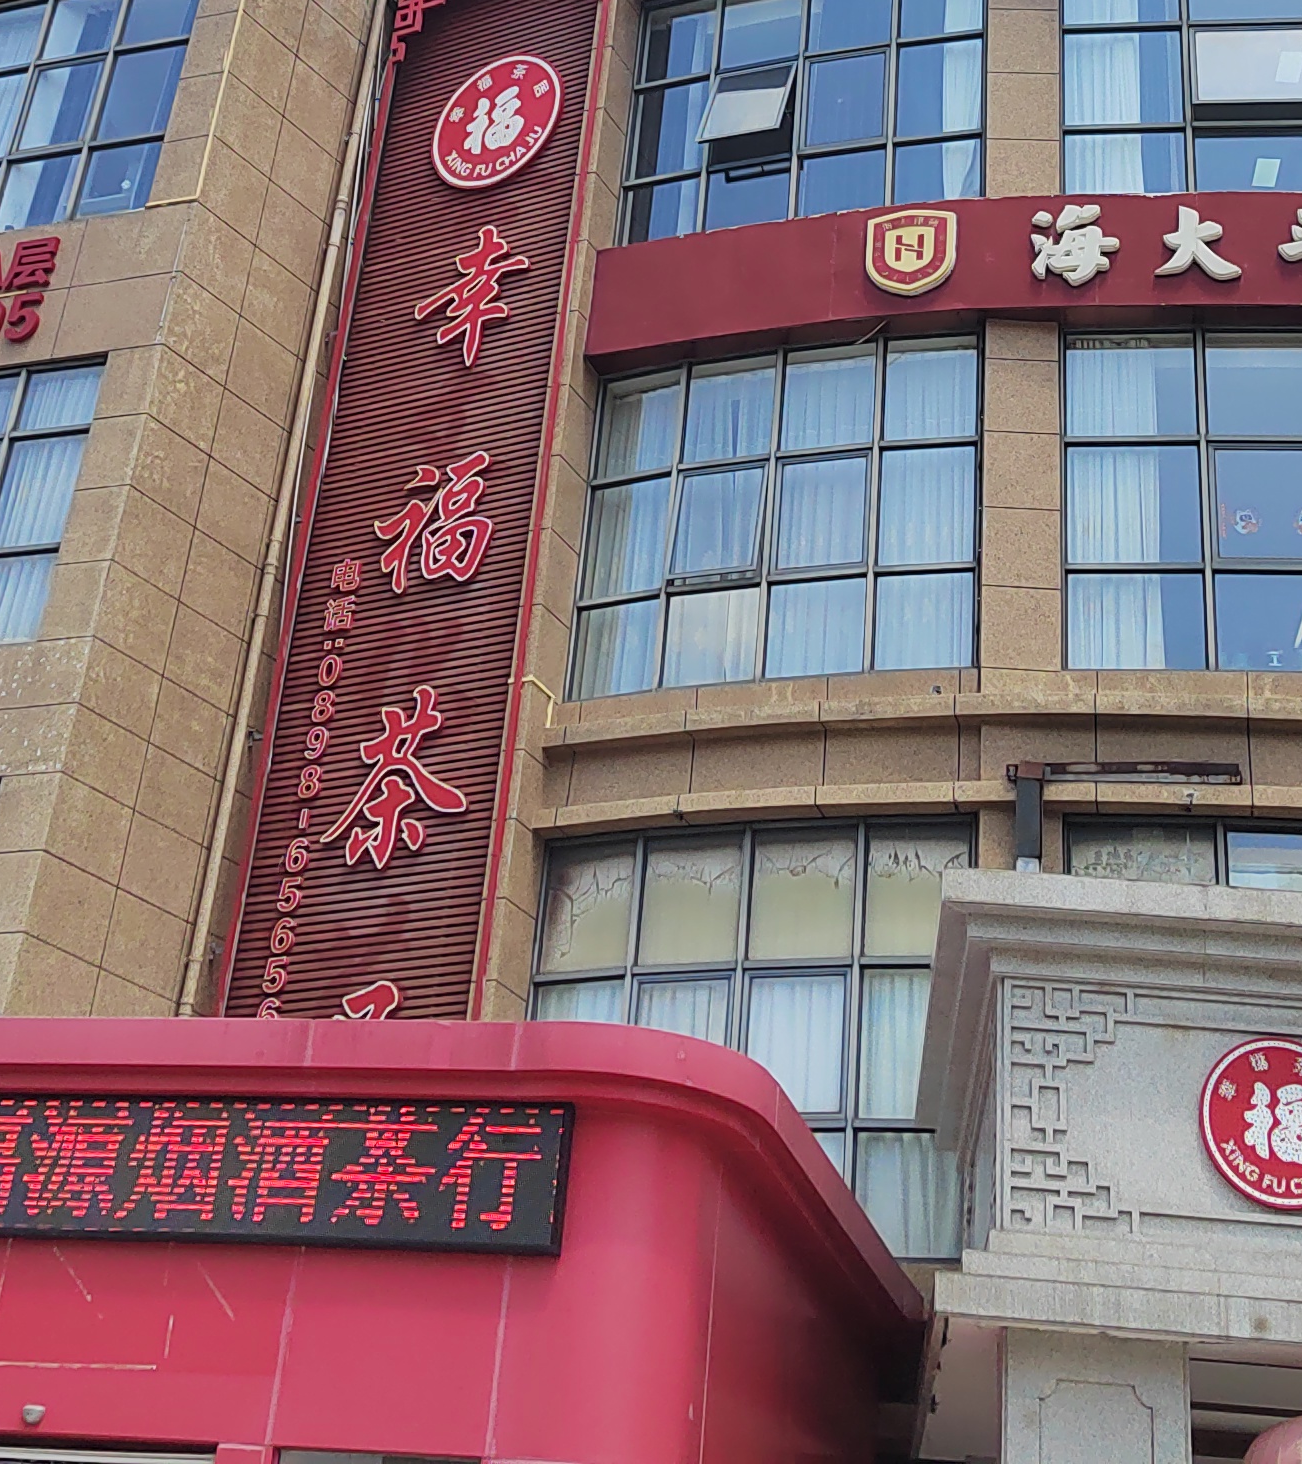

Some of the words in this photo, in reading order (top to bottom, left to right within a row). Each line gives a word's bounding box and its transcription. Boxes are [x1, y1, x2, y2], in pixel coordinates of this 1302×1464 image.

[463, 85, 525, 155] 福
[473, 163, 493, 178] FU
[495, 146, 527, 171] CHA
[320, 225, 532, 1020] 幸福茶
[1220, 1138, 1260, 1182] XING
[1262, 1174, 1286, 1193] FU
